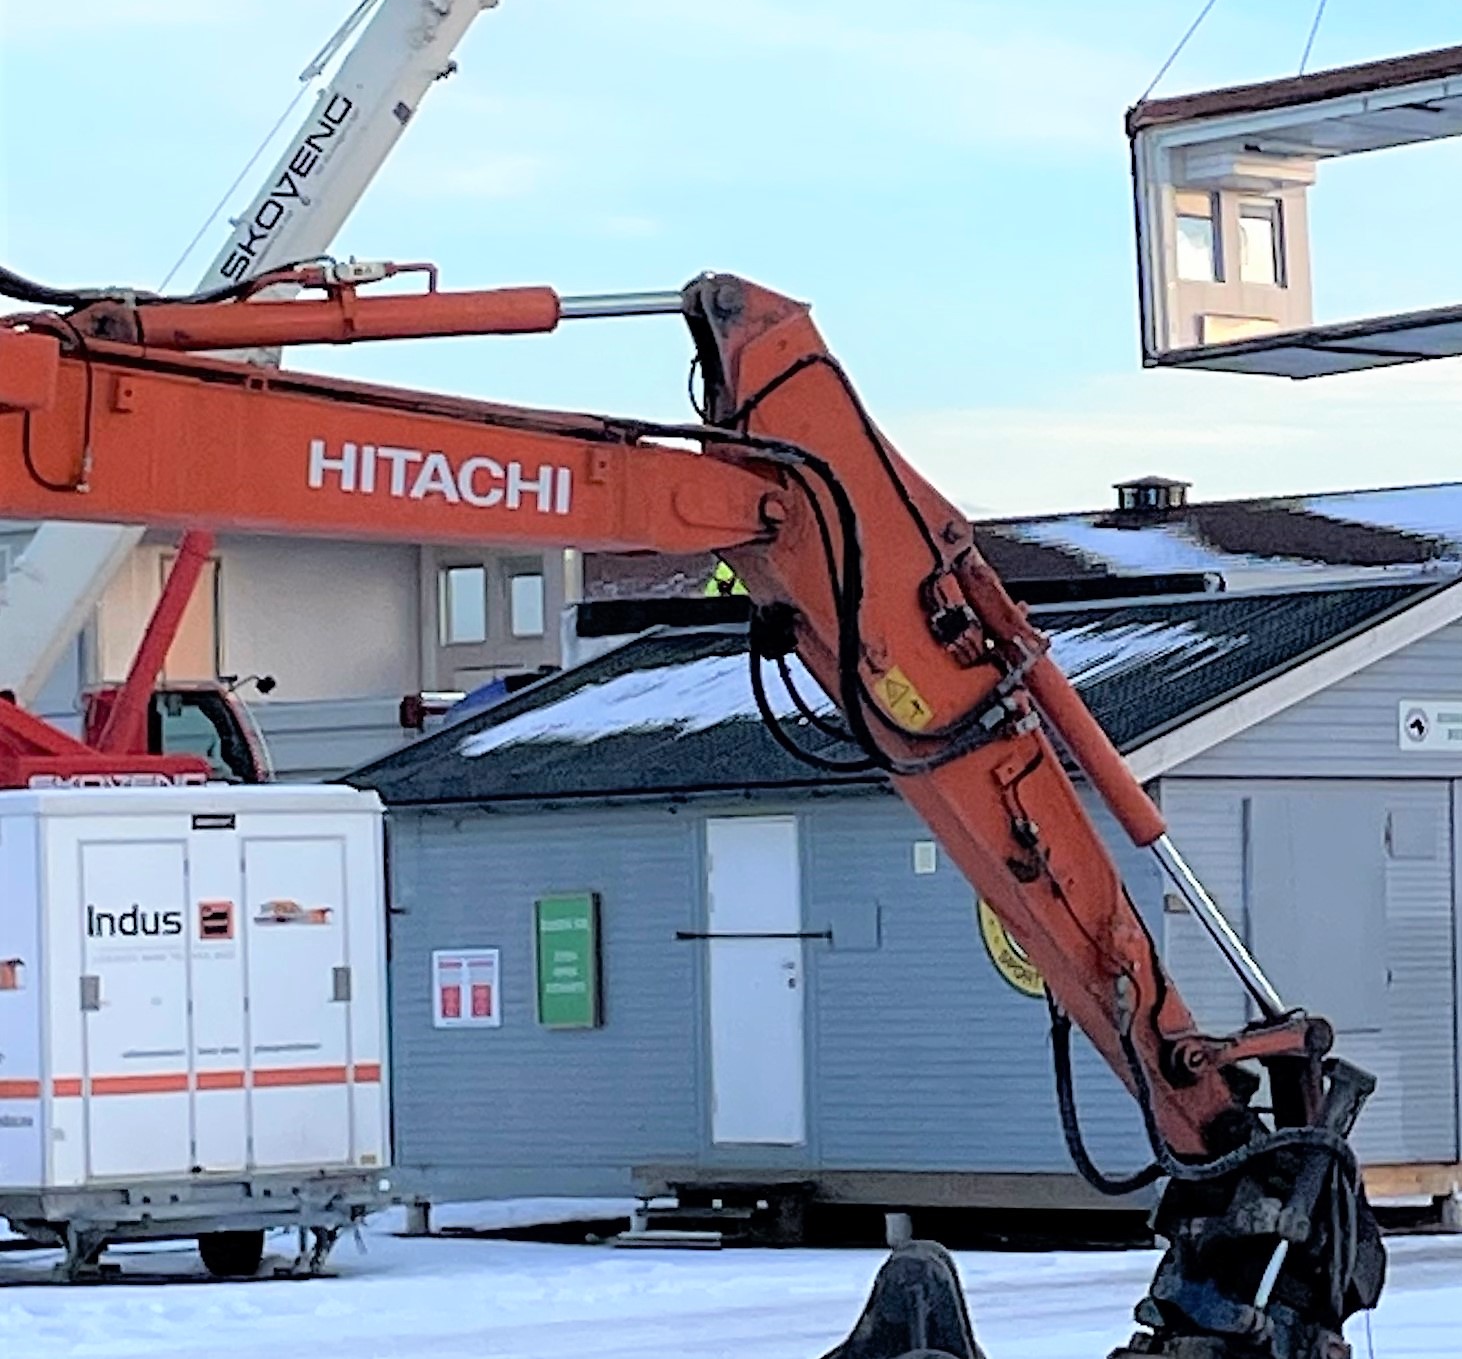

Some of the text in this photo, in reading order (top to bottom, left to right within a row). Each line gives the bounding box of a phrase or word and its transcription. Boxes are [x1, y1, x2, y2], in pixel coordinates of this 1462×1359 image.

[220, 92, 353, 282] SKOVENG
[307, 439, 572, 515] HITACHI
[87, 903, 182, 938] Indus
